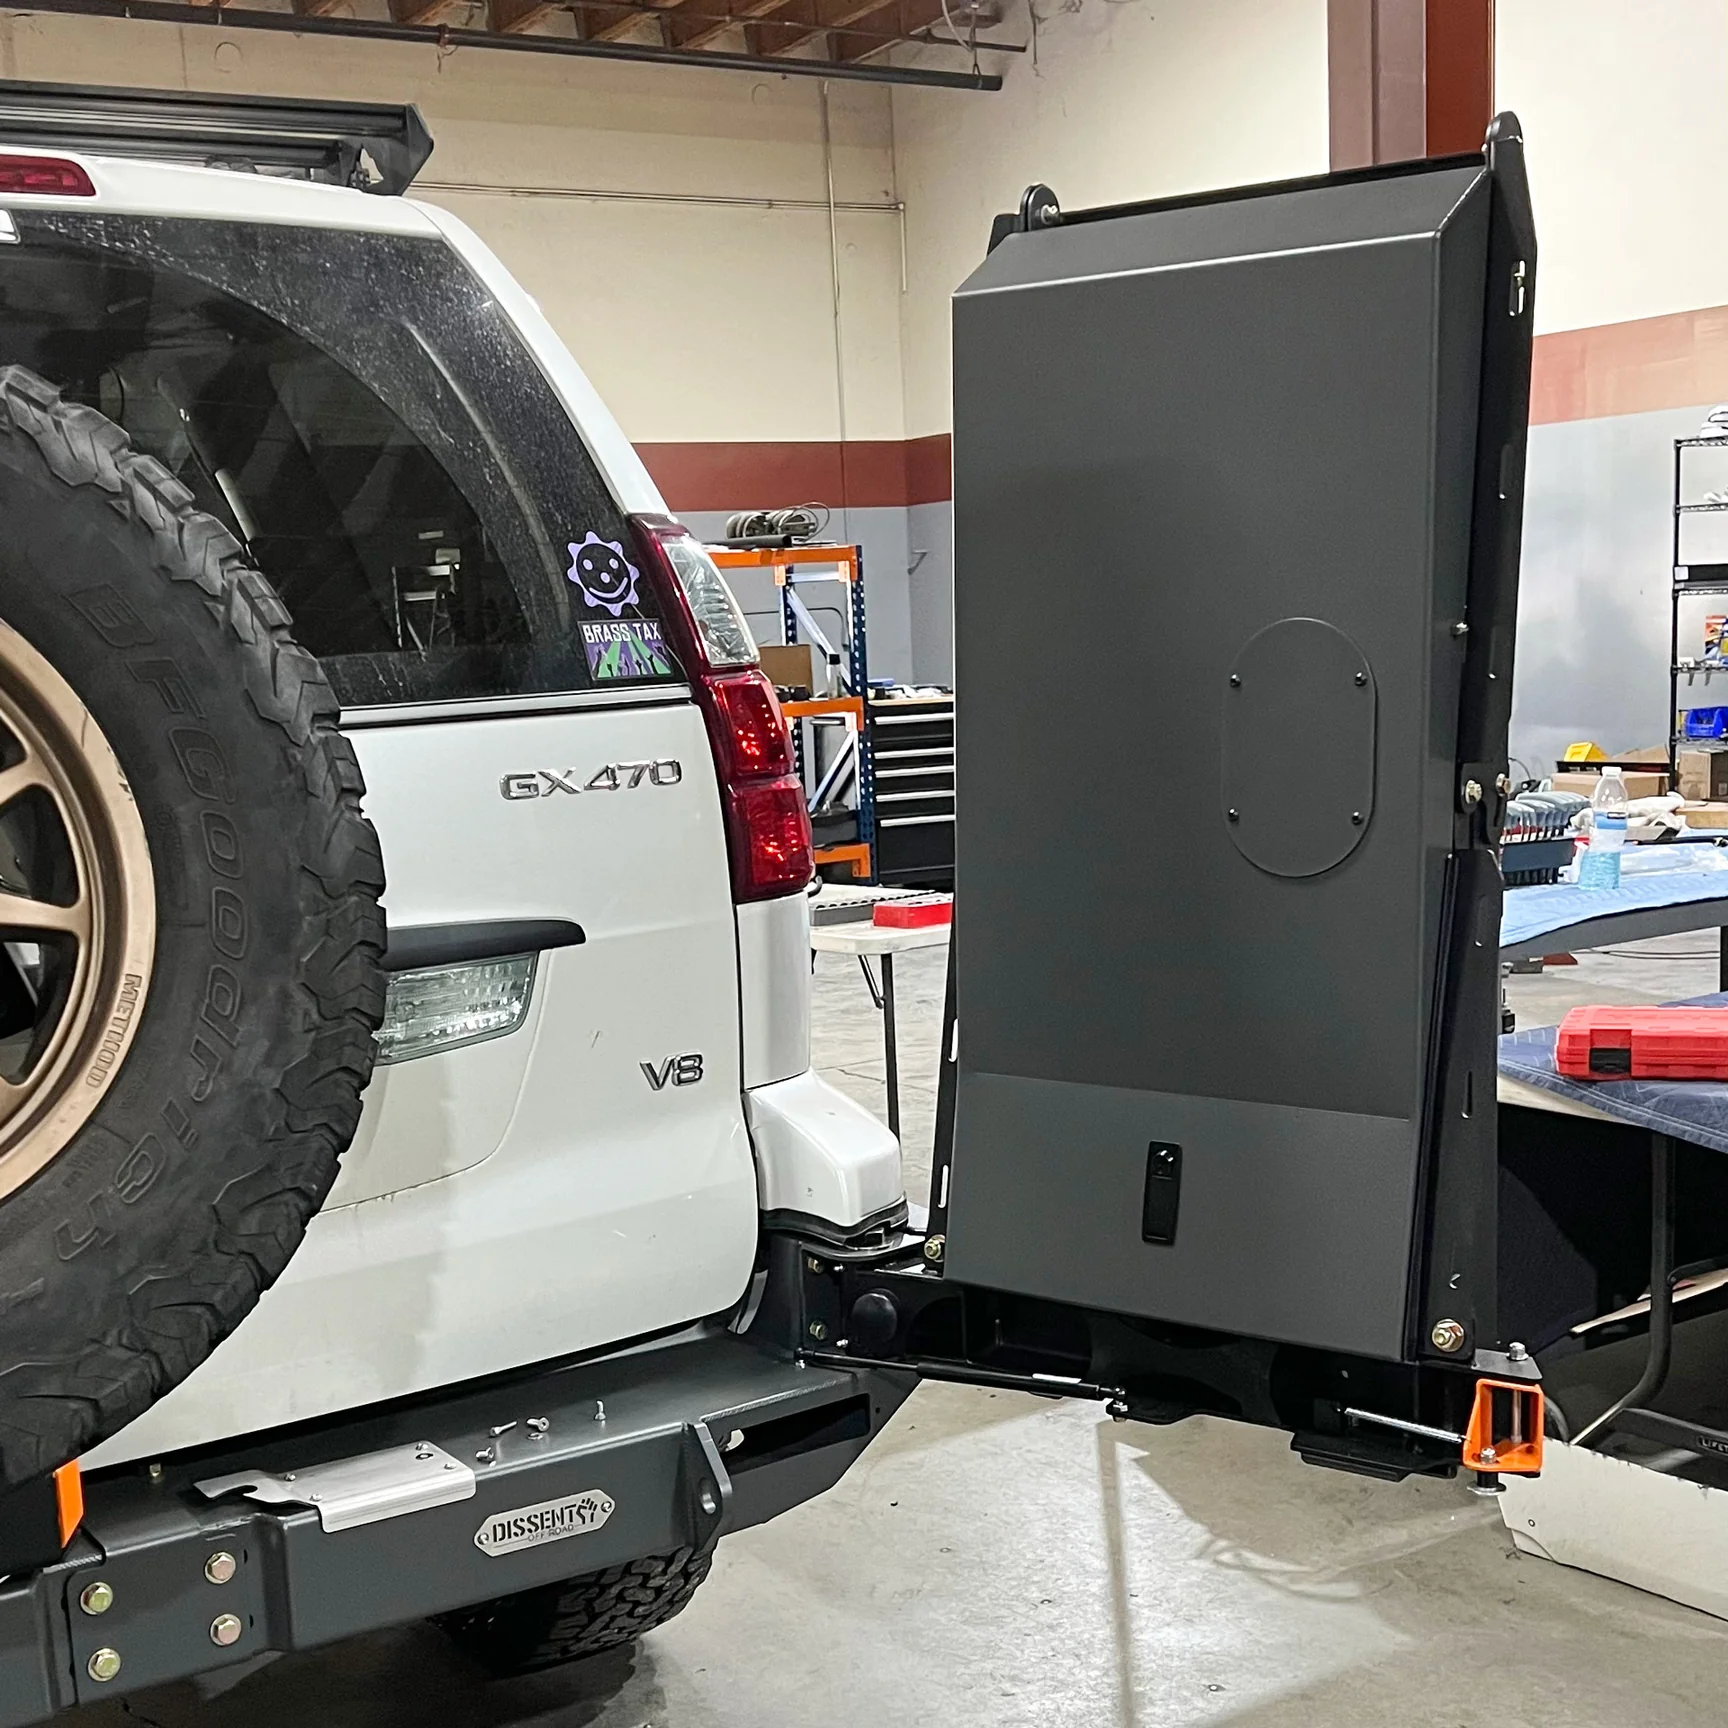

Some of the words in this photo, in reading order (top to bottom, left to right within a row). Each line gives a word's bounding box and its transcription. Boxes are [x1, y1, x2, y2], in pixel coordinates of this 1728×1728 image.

[583, 623, 632, 643] BRASS
[633, 622, 662, 640] TAX
[87, 974, 142, 1088] METHOD
[640, 1052, 703, 1091] V8
[493, 1504, 577, 1542] DISSENT
[527, 1530, 546, 1542] OFF
[548, 1524, 575, 1537] ROAD
